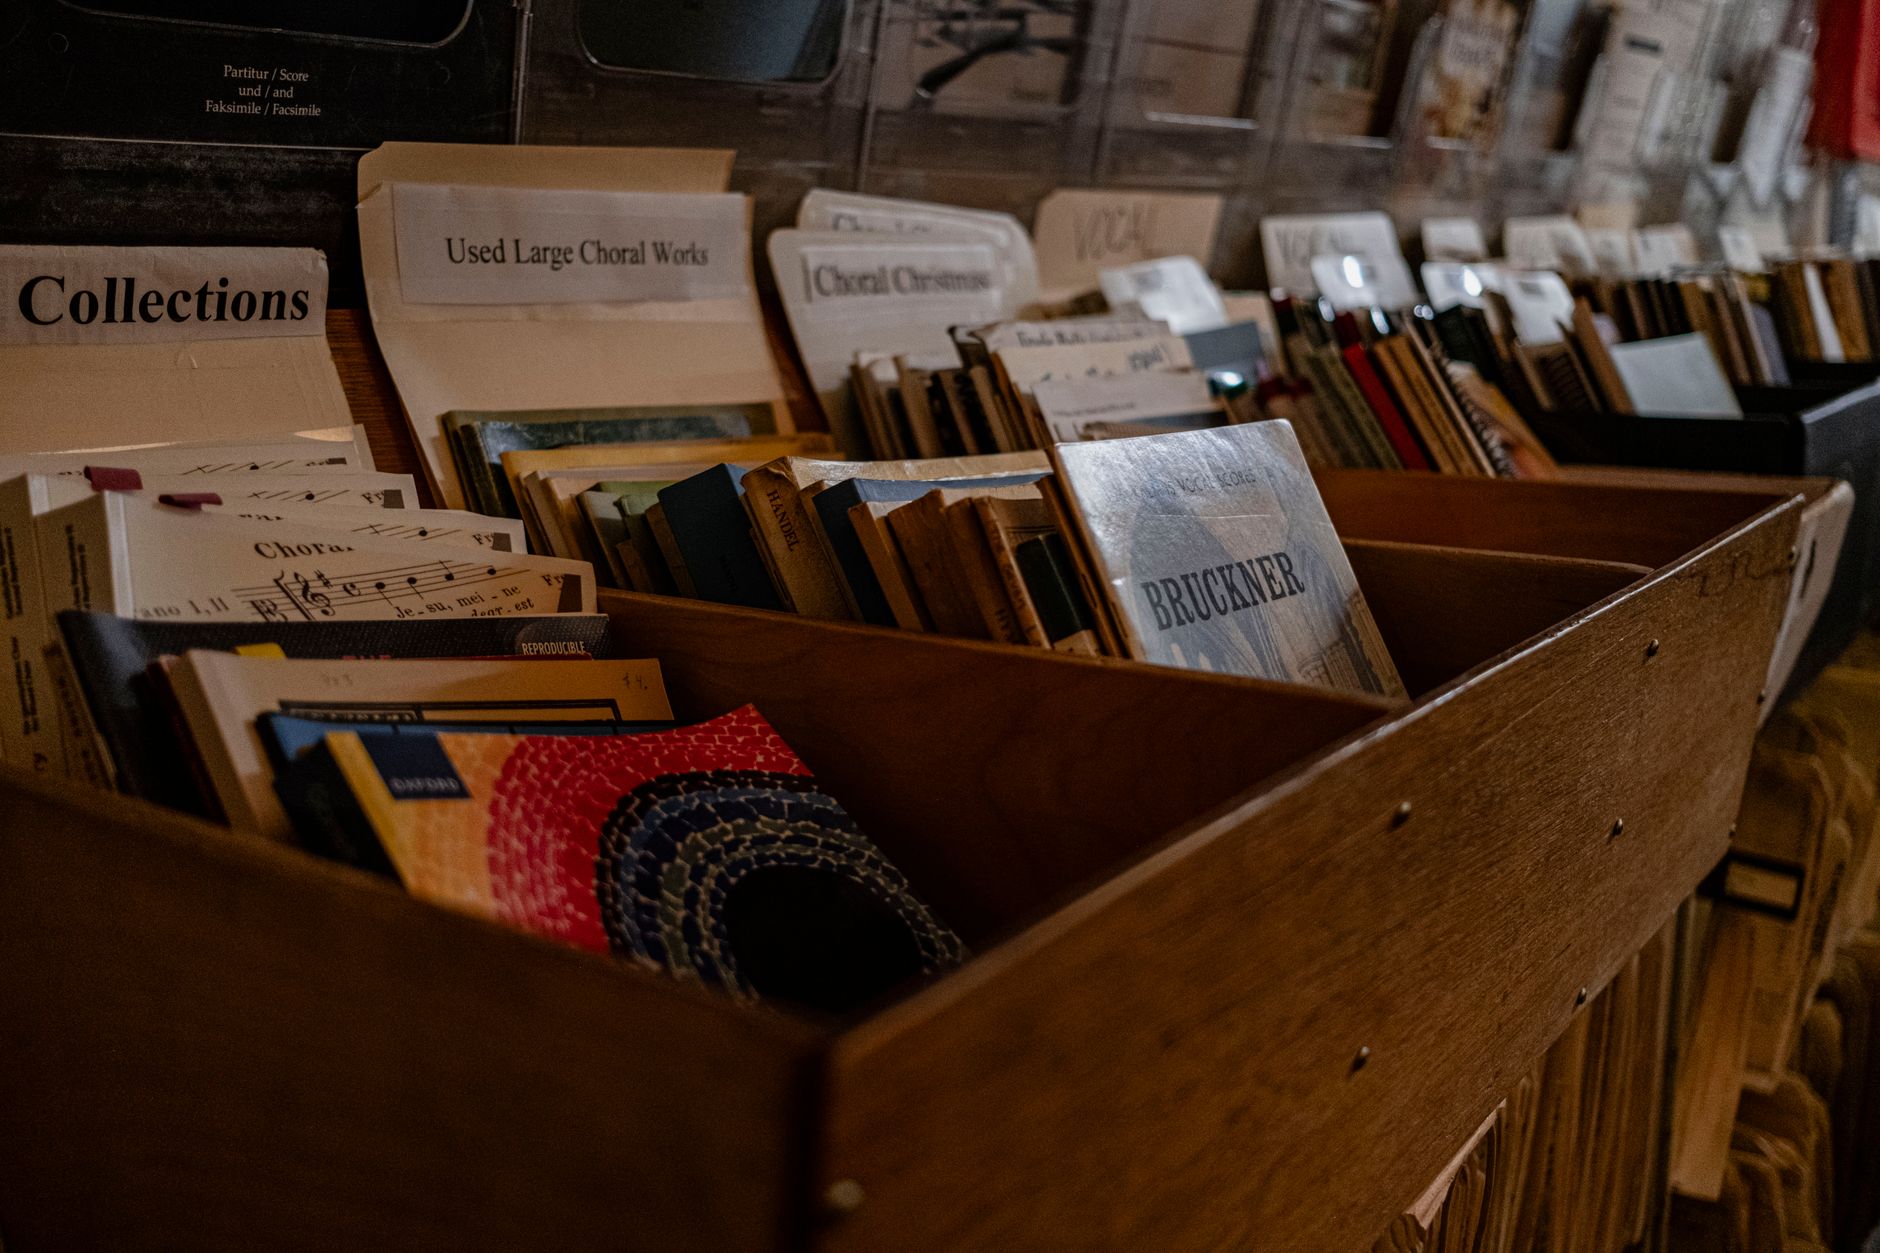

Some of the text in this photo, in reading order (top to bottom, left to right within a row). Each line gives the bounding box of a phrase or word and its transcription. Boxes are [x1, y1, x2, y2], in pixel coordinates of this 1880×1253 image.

[223, 64, 269, 80] Partitur
[279, 68, 310, 82] Score
[238, 84, 262, 97] und
[272, 87, 294, 99] and
[205, 100, 262, 115] Faksimile
[272, 103, 321, 117] Facsimile
[445, 238, 709, 271] Used Large Choral Works
[814, 265, 992, 296] Choral Christmas
[18, 275, 310, 325] Collections
[767, 489, 800, 552] HANDEL
[254, 541, 355, 560] Chora
[1141, 551, 1306, 632] BRUCKNER
[521, 641, 586, 656] REPRODUCIBLE
[390, 776, 460, 792] OXFORD
